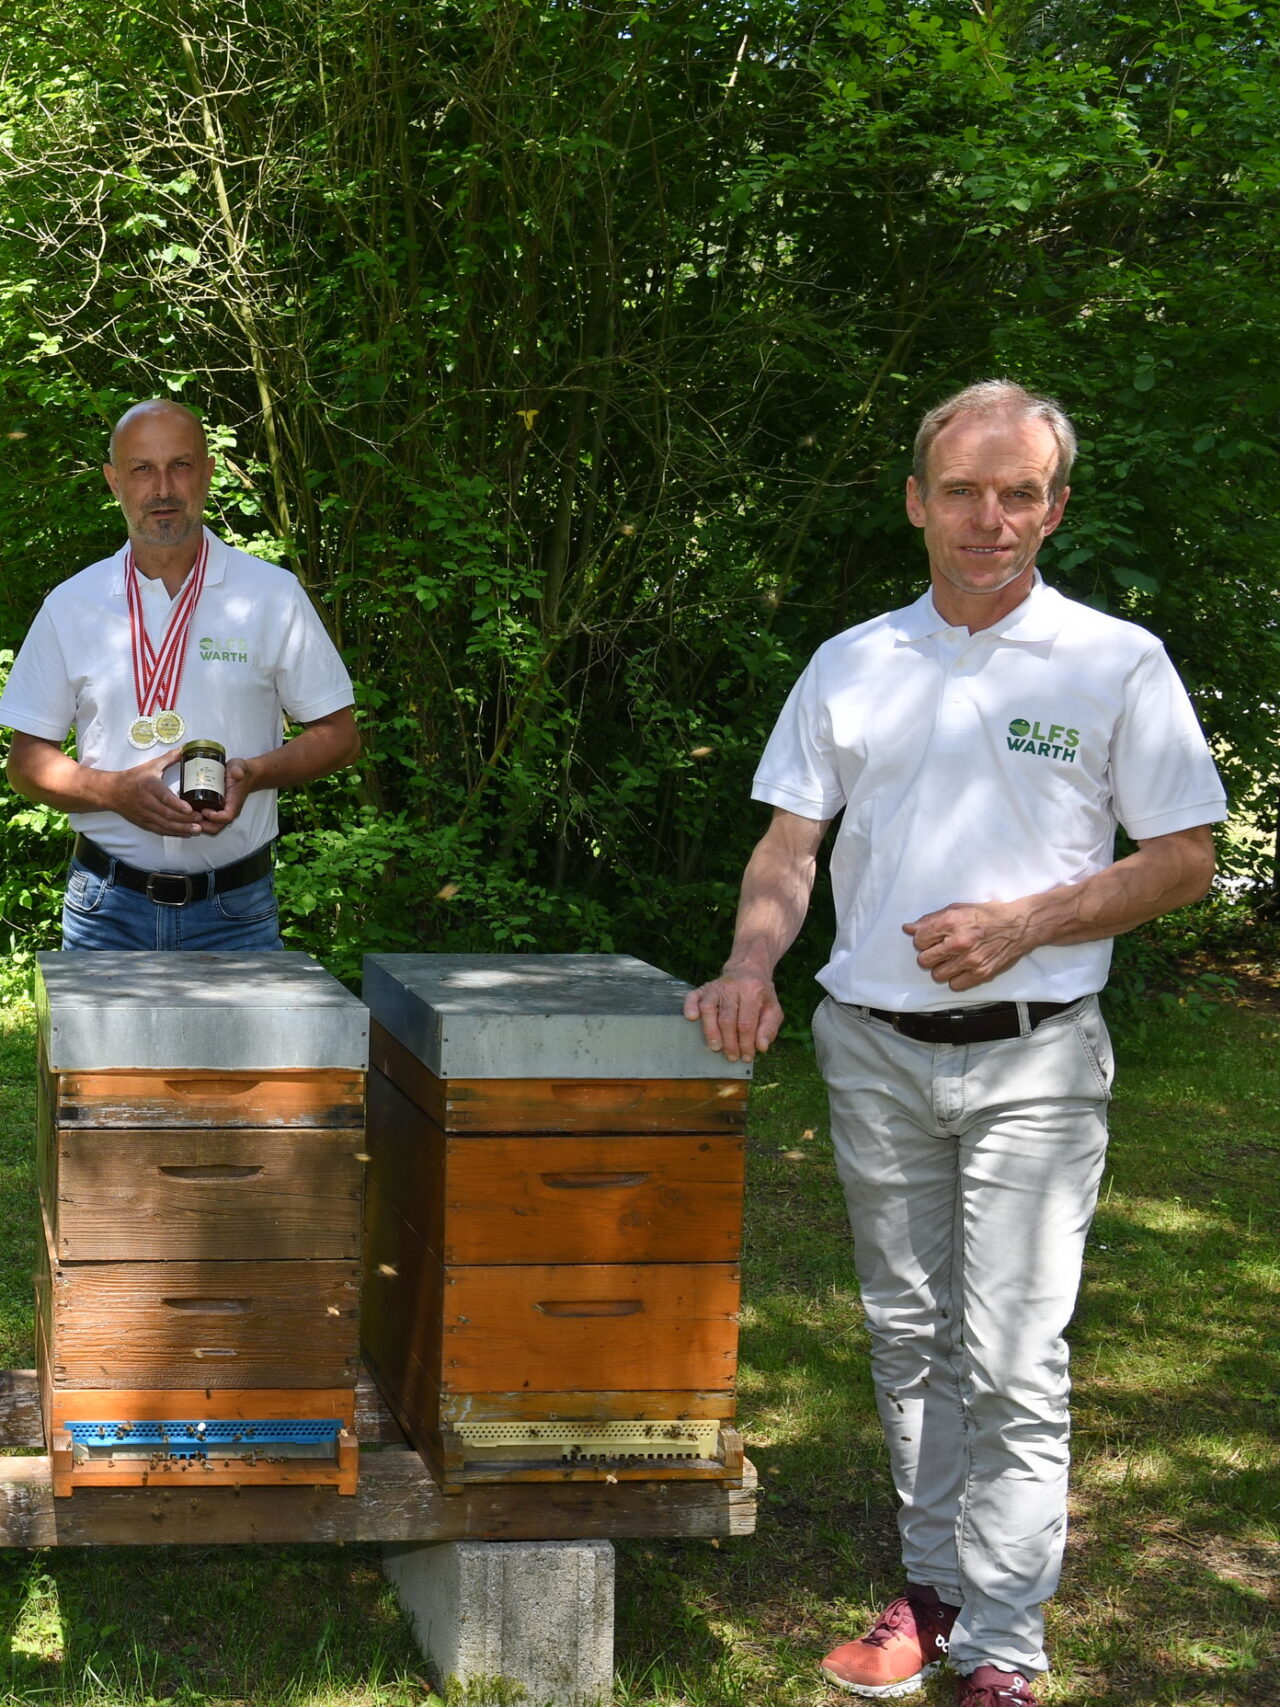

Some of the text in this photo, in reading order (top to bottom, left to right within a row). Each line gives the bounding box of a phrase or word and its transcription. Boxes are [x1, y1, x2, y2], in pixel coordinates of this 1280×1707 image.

[200, 651, 247, 663] WARTH
[1032, 721, 1080, 748] LFS
[1006, 736, 1076, 763] WARTH
